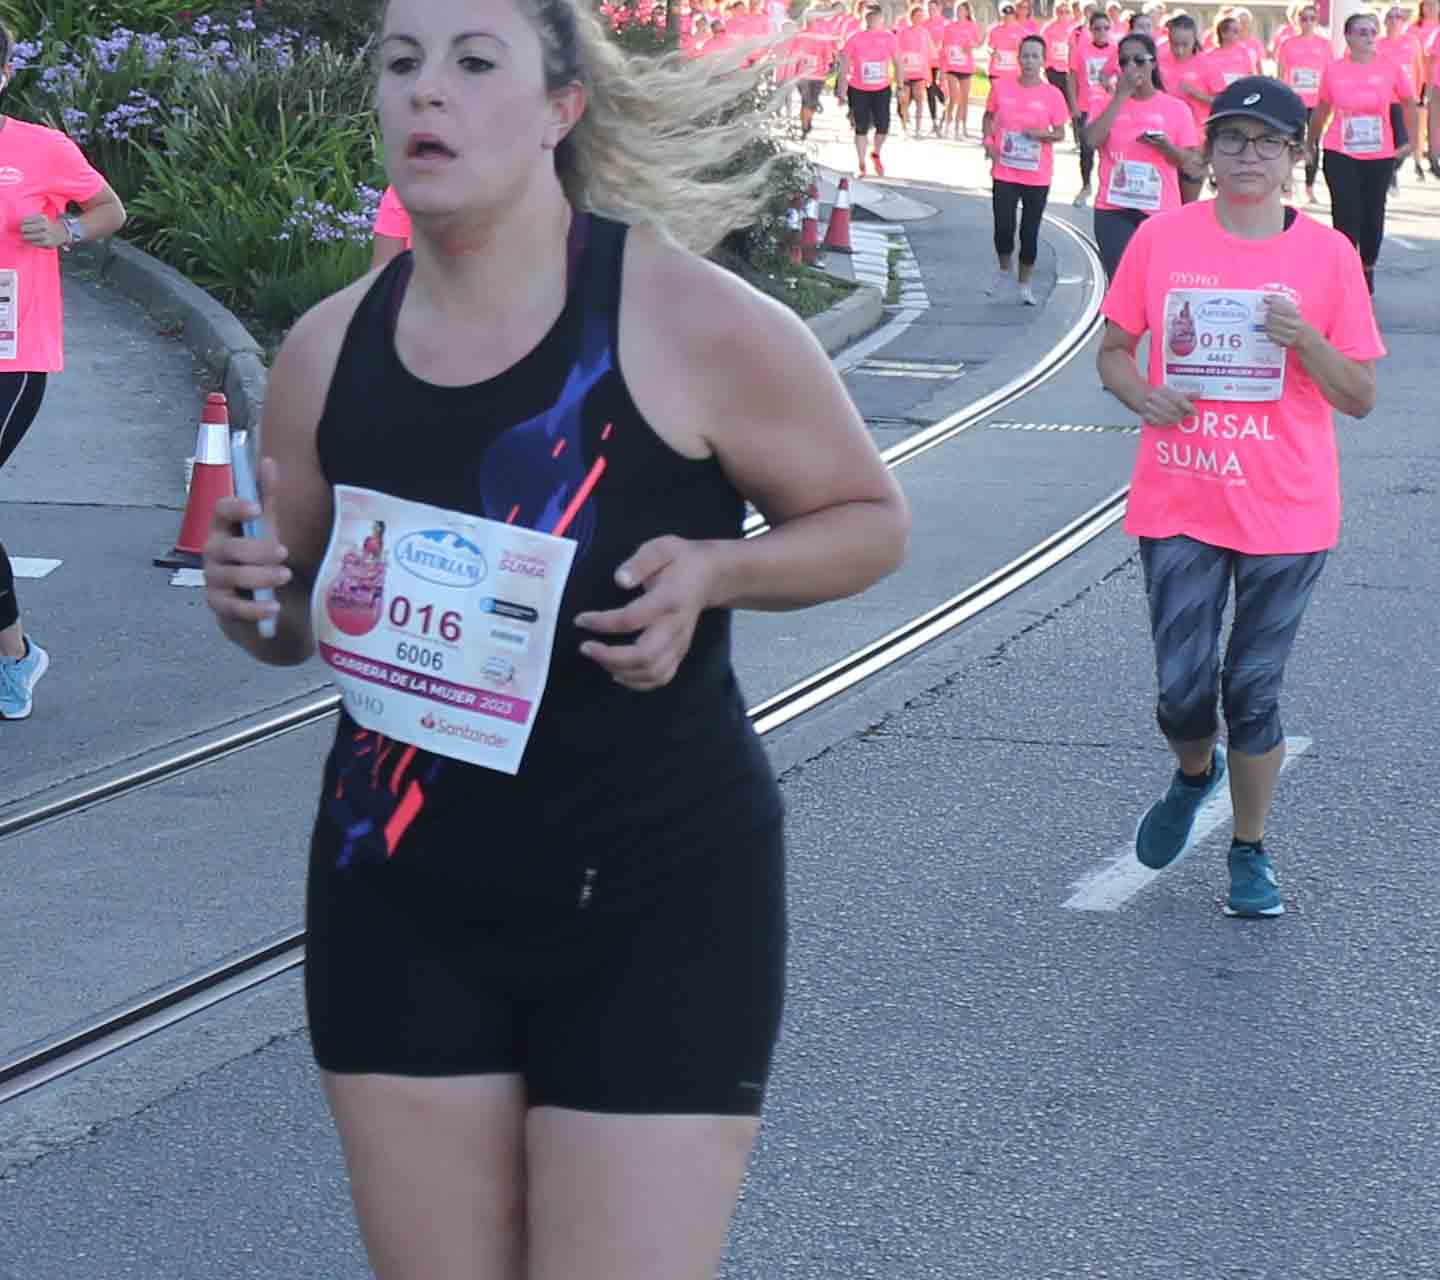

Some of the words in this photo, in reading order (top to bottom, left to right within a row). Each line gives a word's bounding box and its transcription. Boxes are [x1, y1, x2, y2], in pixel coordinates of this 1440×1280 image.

[1199, 332, 1242, 349] 016
[1177, 409, 1276, 440] ORSAL
[1155, 439, 1244, 477] SUMA
[389, 594, 463, 642] 016
[396, 641, 444, 671] 6006
[331, 652, 387, 680] CARRERA
[389, 670, 409, 688] DE
[409, 676, 428, 693] LA
[430, 683, 477, 706] MUJER
[436, 717, 511, 749] Santander
